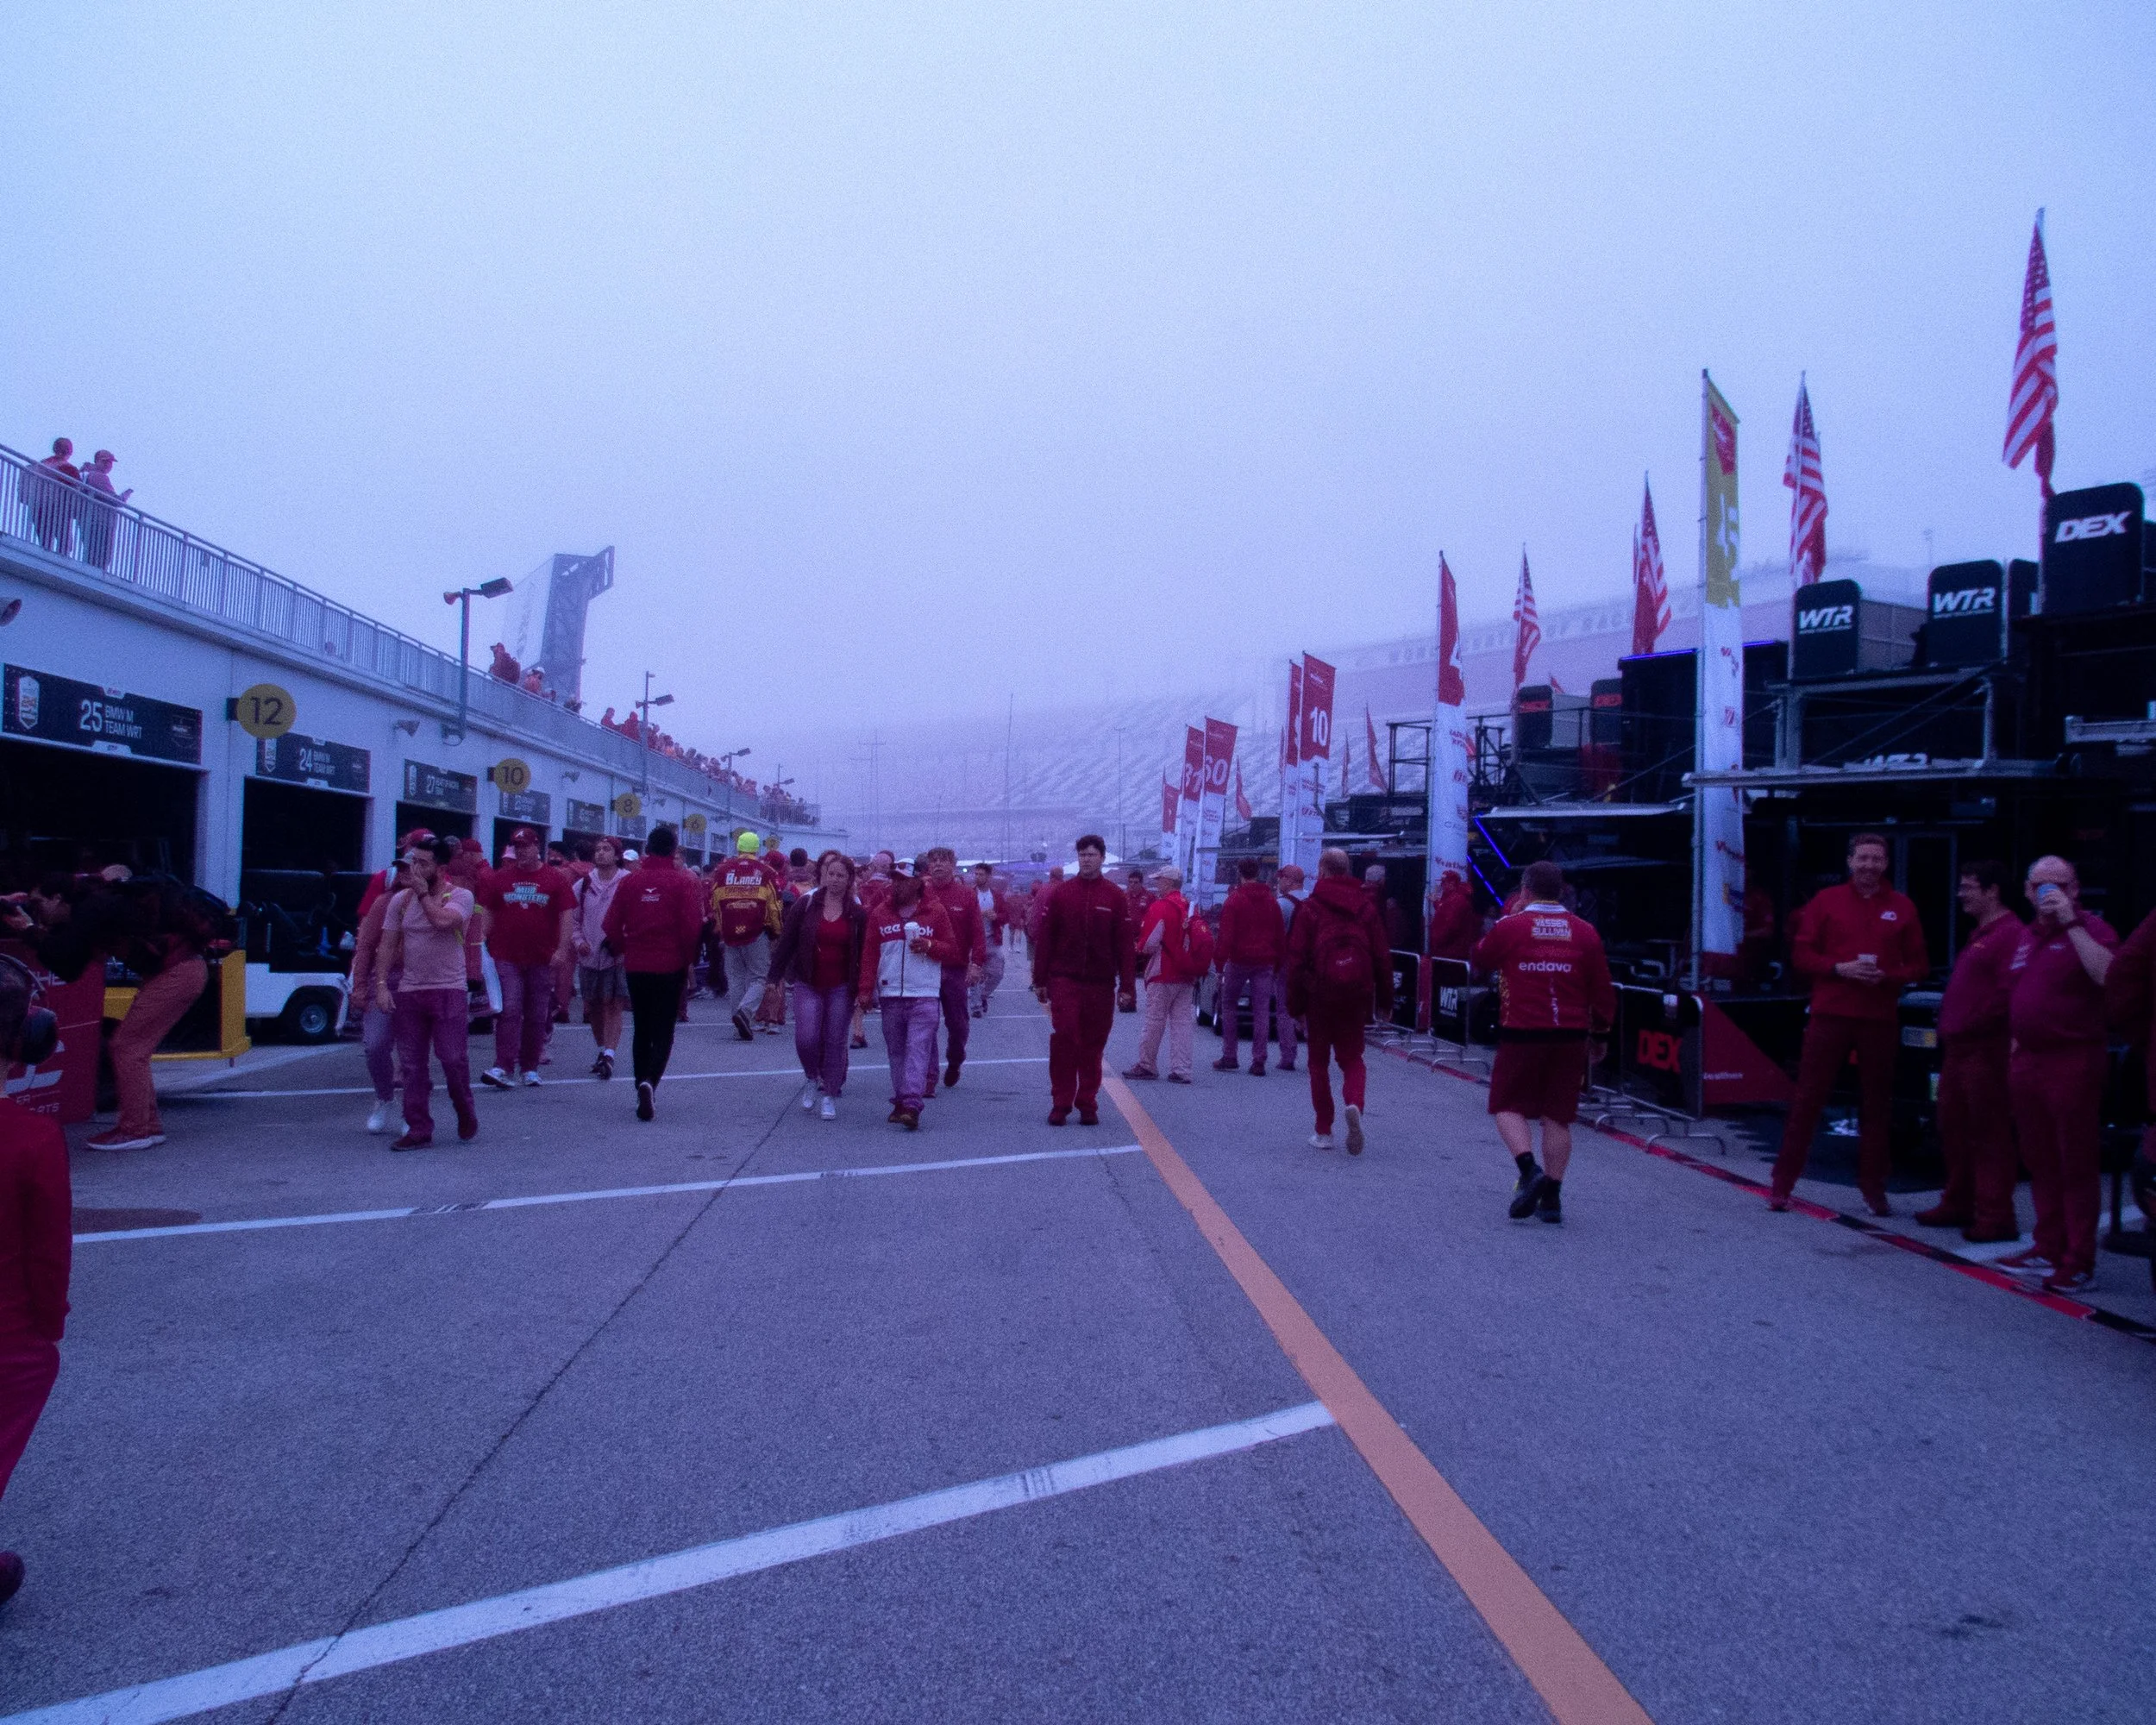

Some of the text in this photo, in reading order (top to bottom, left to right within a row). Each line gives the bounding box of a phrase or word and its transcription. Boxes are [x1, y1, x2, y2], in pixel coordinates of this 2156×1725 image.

[2055, 510, 2134, 543] DEX
[1934, 586, 1996, 613] WTR
[1798, 605, 1854, 630] WTR
[79, 699, 103, 733] 25
[105, 705, 125, 721] BMW
[250, 696, 285, 725] 12
[104, 719, 142, 739] TEAM WRT
[1309, 706, 1329, 747] 10
[299, 748, 313, 773] 24
[503, 765, 524, 786] 10
[624, 798, 633, 814] 8
[1519, 961, 1572, 973] endava
[1440, 986, 1458, 1011] WTR
[1638, 1030, 1683, 1074] DEX
